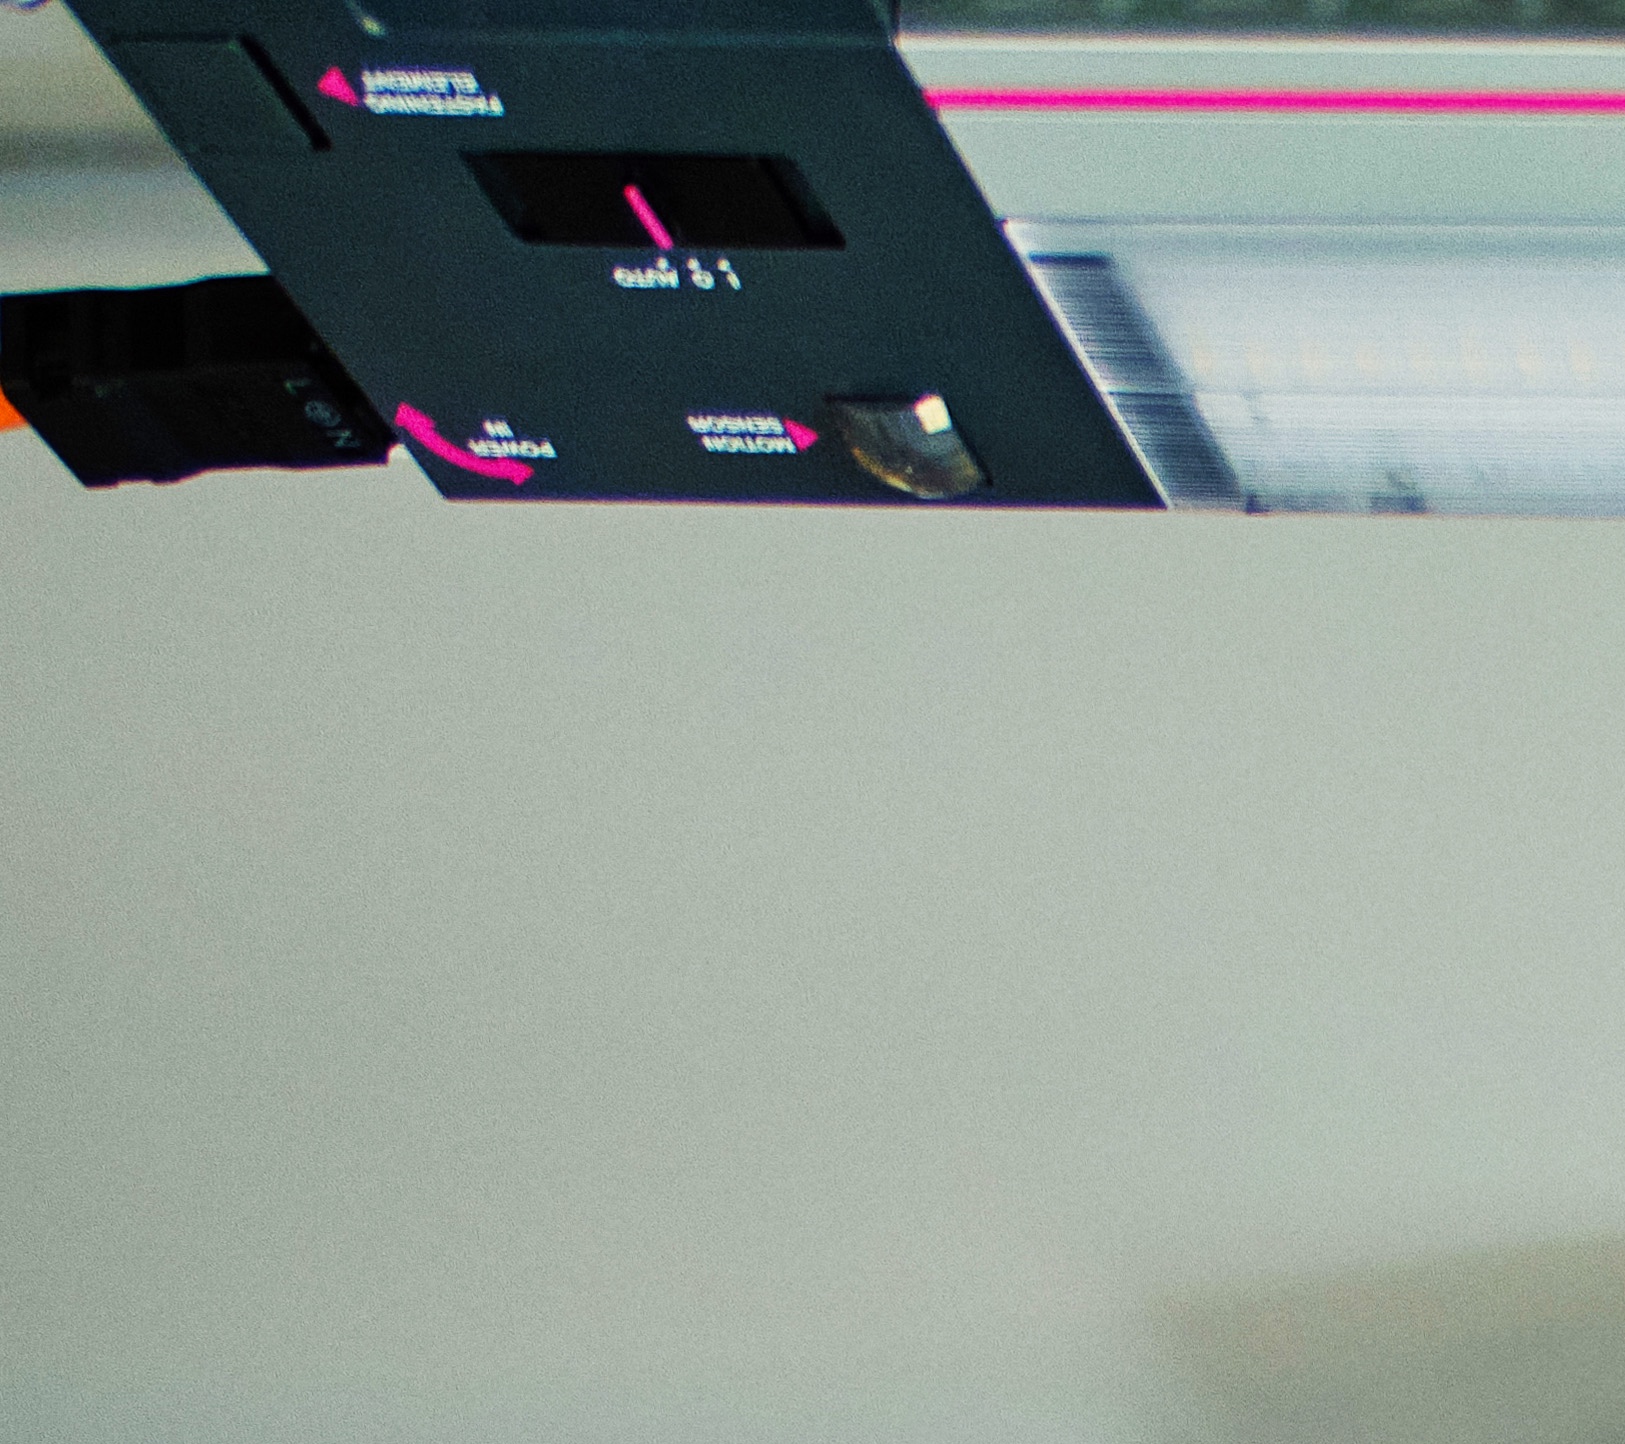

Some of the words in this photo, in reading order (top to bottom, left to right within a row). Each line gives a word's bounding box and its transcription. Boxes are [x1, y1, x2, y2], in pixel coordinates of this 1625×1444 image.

[482, 419, 512, 438] IN
[685, 414, 786, 434] SENSOR
[467, 438, 557, 459] POWER
[702, 434, 796, 454] MOTION
